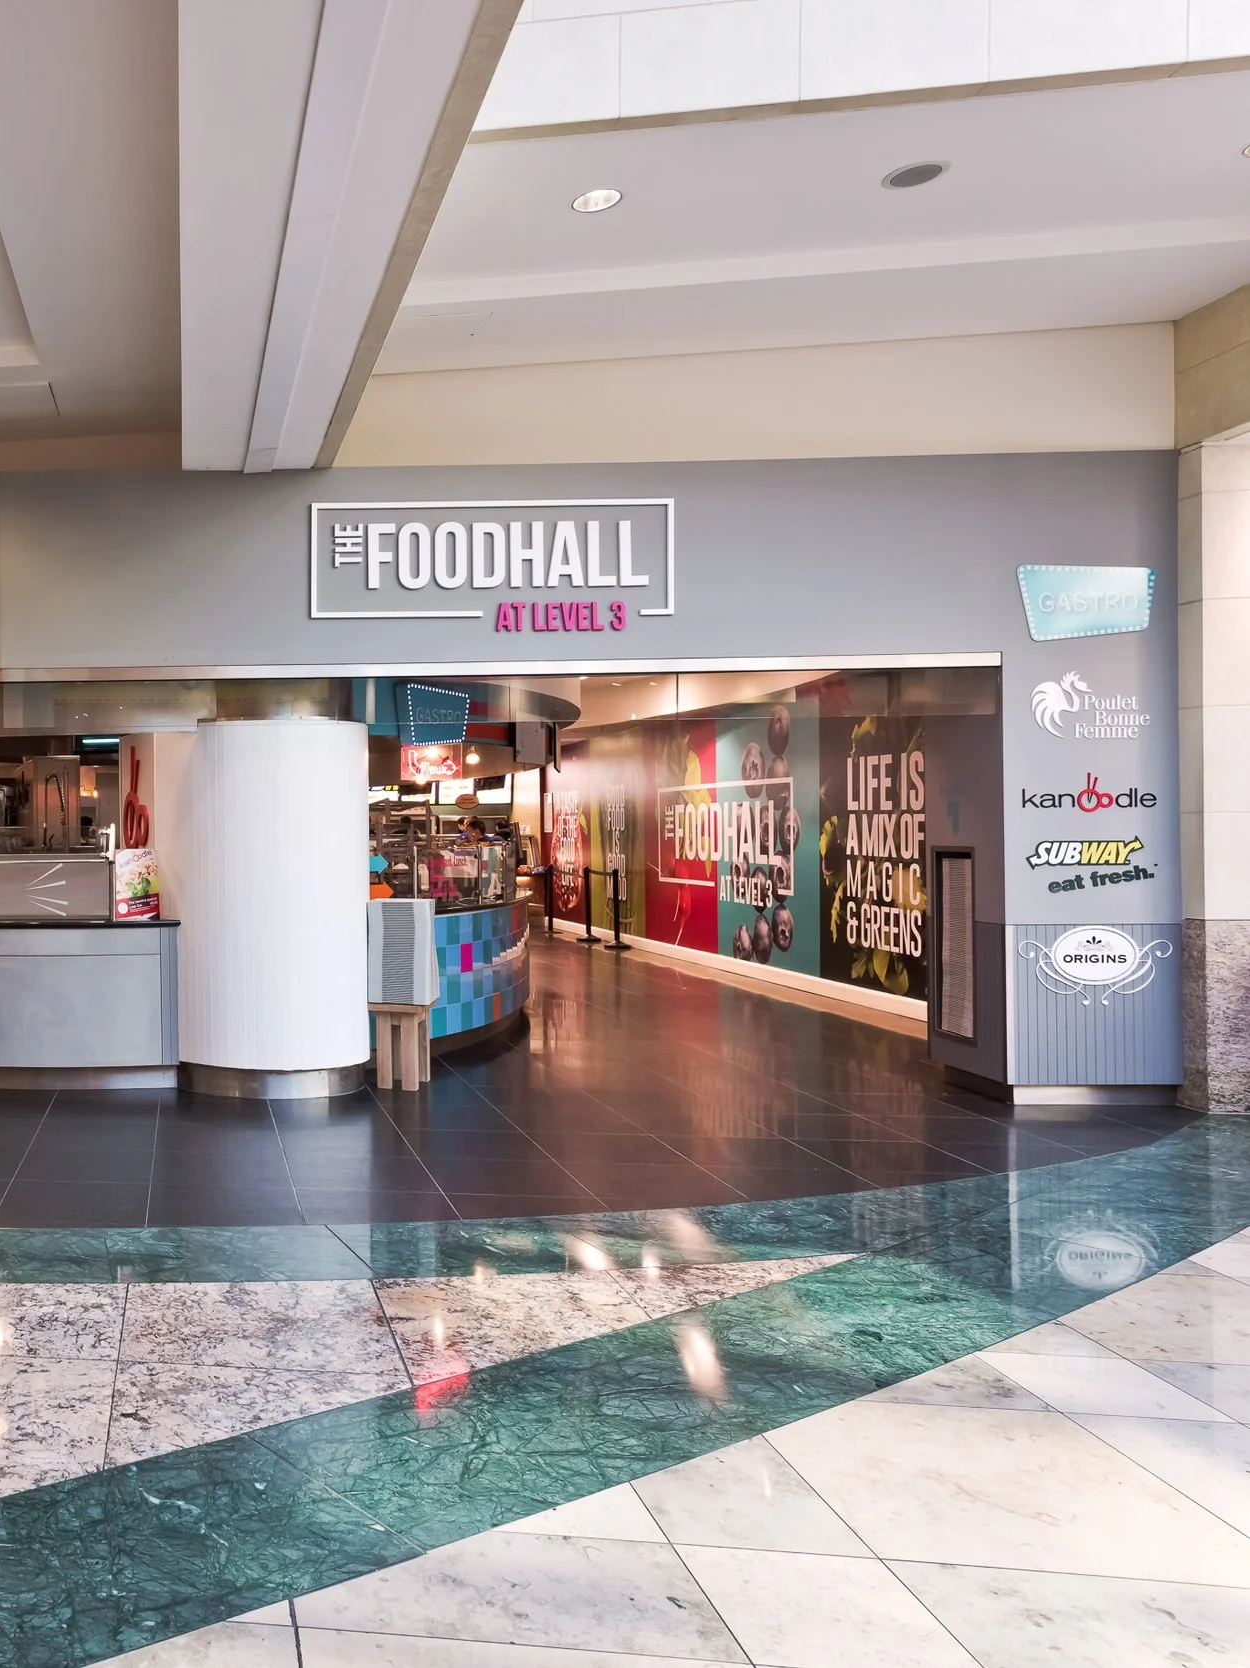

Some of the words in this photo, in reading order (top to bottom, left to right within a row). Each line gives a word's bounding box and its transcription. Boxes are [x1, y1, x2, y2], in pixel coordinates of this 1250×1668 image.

[333, 522, 364, 568] THE
[366, 520, 650, 590] FOODHALL
[1038, 591, 1138, 613] GASTRO
[495, 602, 527, 633] AT
[532, 601, 605, 632] LEVEL
[610, 600, 628, 631] 3
[1083, 694, 1139, 711] Poulet
[416, 706, 463, 725] GASTRO
[1094, 710, 1151, 727] Bonne
[1074, 722, 1139, 739] Femme
[846, 753, 893, 811] LIFE
[900, 750, 925, 811] IS
[607, 784, 625, 807] GOOD
[1021, 783, 1158, 813] kanoodle
[565, 815, 577, 838] THE
[607, 807, 625, 831] FOOD
[612, 831, 620, 854] IS
[664, 804, 674, 840] THE
[674, 799, 782, 866] FOODHALL
[846, 813, 859, 856] A
[861, 813, 897, 858] MIX
[900, 812, 925, 860] OF
[607, 853, 626, 877] GOOD
[1025, 835, 1145, 871] SUBWAY
[606, 877, 627, 901] MOD
[719, 875, 732, 902] AT
[733, 875, 764, 907] LEVEL
[765, 879, 773, 908] 3
[846, 859, 921, 906] MAGIC
[1048, 874, 1085, 894] eat
[846, 900, 859, 945] &
[860, 902, 922, 958] GREENS
[1062, 953, 1128, 964] ORIGINS
